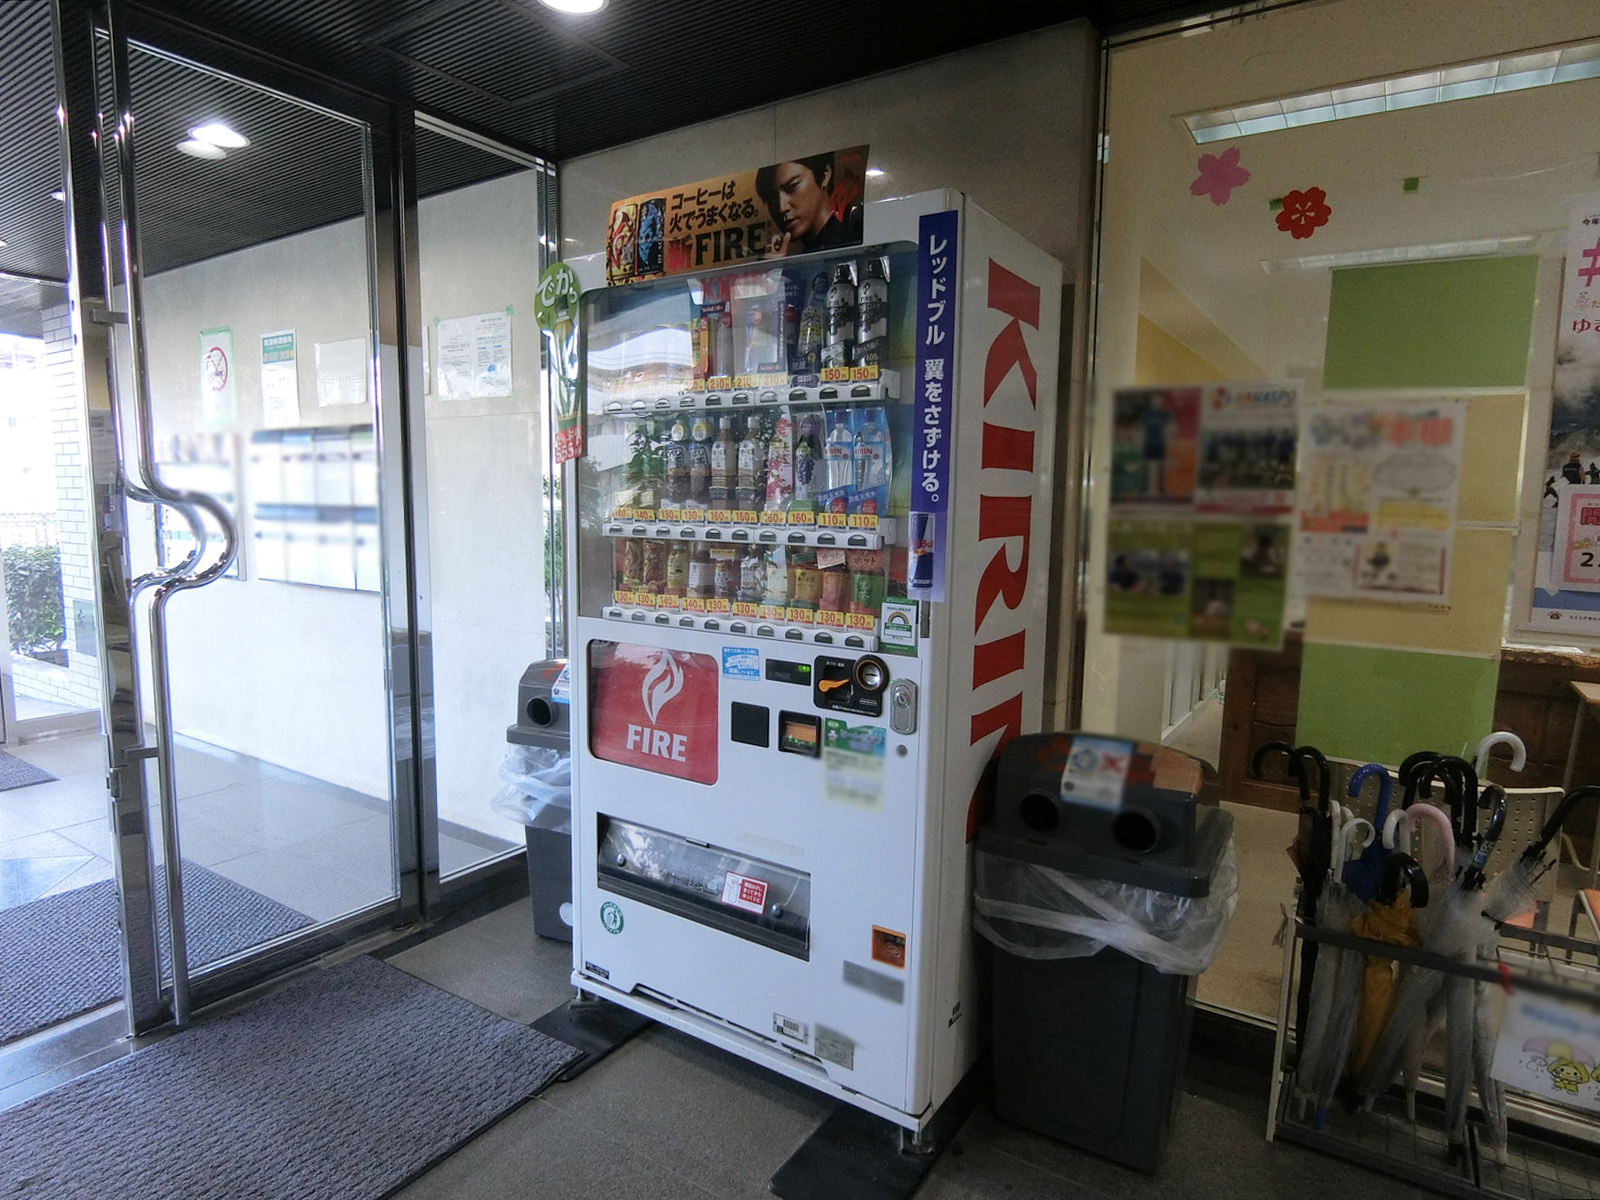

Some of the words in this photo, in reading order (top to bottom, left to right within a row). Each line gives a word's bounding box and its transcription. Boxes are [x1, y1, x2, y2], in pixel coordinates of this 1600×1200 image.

[671, 180, 736, 211] コーヒーは
[669, 198, 759, 234] 火でうまくなる。
[695, 222, 767, 266] FIRE
[925, 235, 948, 346] レッドブル
[921, 358, 945, 502] 翼をさずける。
[1580, 552, 1600, 567] 2
[626, 723, 688, 763] FIRE
